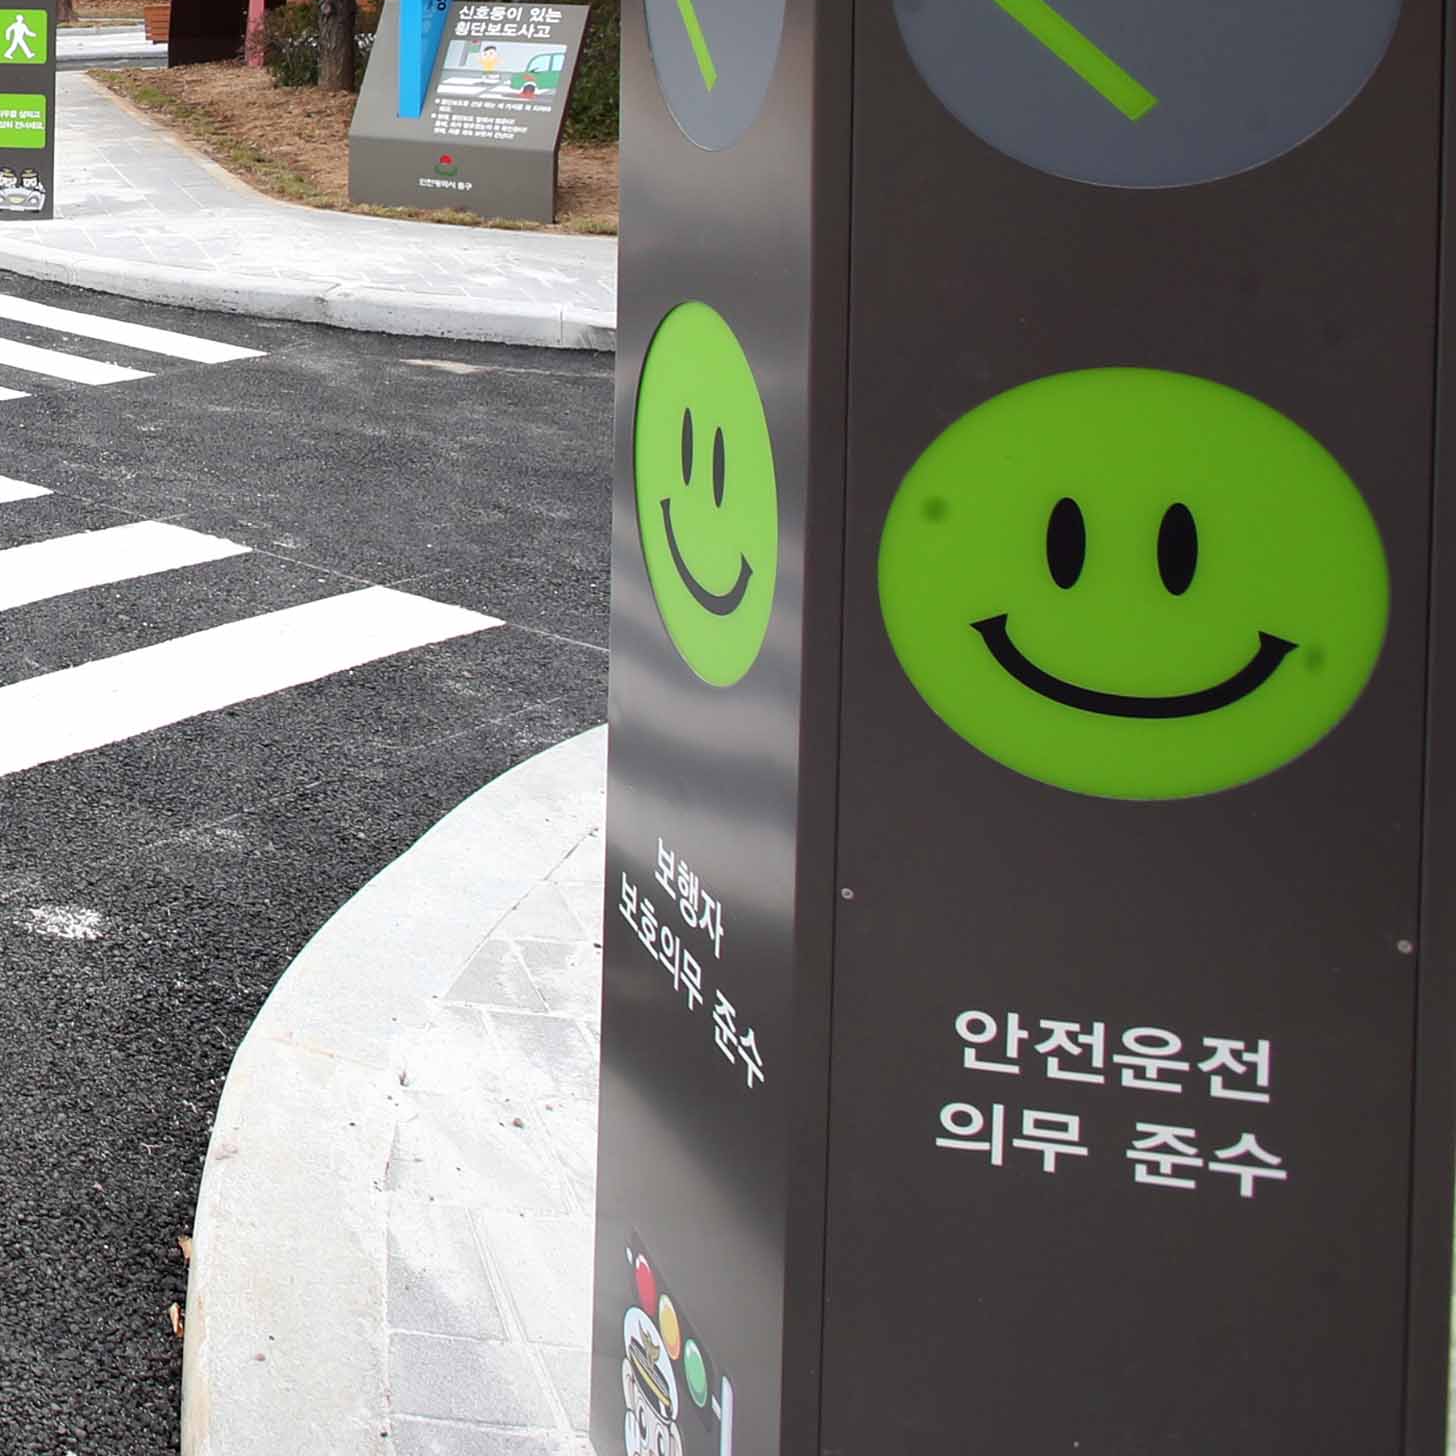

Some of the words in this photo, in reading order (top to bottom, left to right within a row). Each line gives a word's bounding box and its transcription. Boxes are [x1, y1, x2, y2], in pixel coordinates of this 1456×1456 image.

[454, 20, 552, 39] 횡단보도사고
[458, 5, 524, 22] 신호등이
[528, 6, 563, 23] 있는
[654, 835, 725, 960] 보행자
[618, 871, 704, 1012] 보호의무
[712, 989, 766, 1089] 준수
[954, 1009, 1271, 1104] 안전운전
[935, 1101, 1089, 1174] 의무
[1125, 1121, 1289, 1198] 준수
